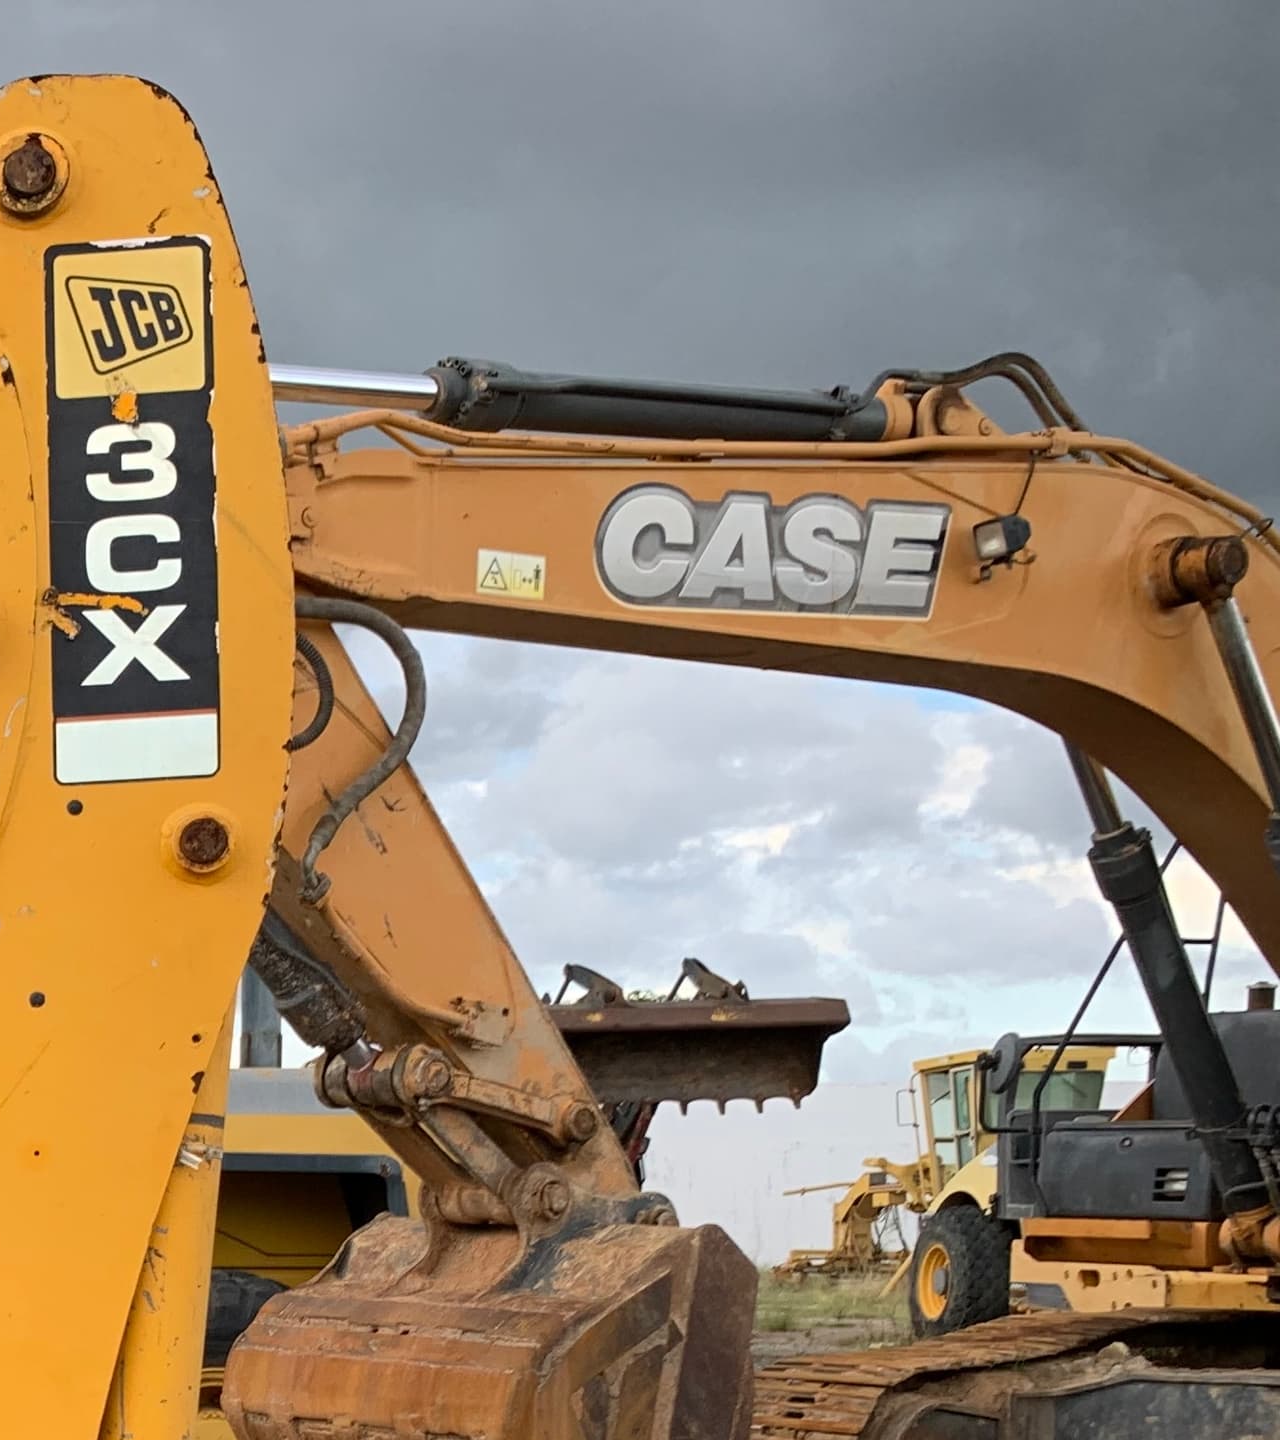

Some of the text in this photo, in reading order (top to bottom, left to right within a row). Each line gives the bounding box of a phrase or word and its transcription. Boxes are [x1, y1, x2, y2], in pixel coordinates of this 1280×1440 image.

[87, 286, 184, 362] JCB
[81, 421, 191, 687] 3CX
[601, 492, 945, 608] CASE
